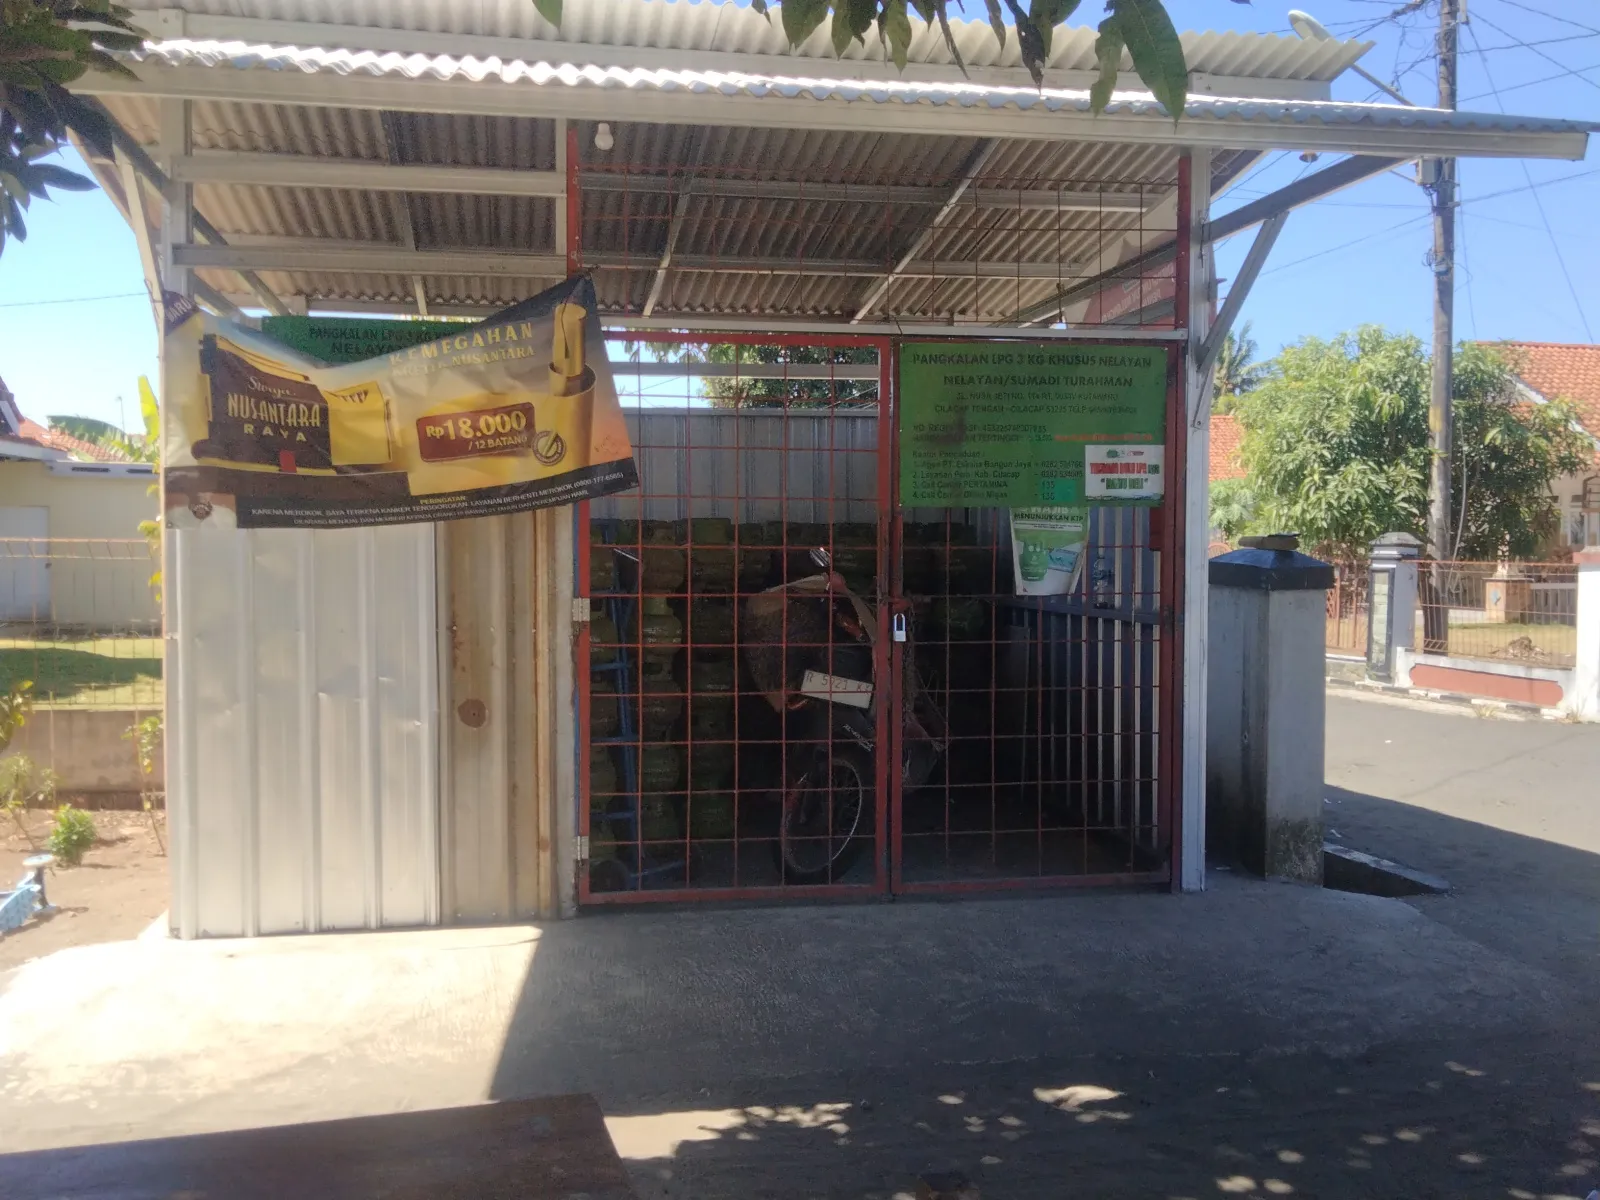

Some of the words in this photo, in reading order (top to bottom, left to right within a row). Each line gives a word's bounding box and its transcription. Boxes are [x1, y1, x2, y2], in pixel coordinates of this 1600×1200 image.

[390, 322, 533, 366] KEMEGAHAN
[451, 345, 536, 366] NUSANTARA
[913, 353, 989, 365] PANGKALAN
[992, 353, 1014, 365] LPG
[1017, 354, 1025, 364] 3
[1028, 353, 1045, 365] KG
[1048, 354, 1096, 366] KHUSUS
[1098, 355, 1152, 368] NELAYAN
[1064, 375, 1133, 388] TURAHMAN
[228, 391, 320, 428] NUSANTARA
[243, 422, 308, 442] RAYA
[425, 410, 526, 441] Rp18.000
[1014, 460, 1032, 471] Jaya
[992, 470, 1020, 482] Cilacap
[964, 480, 1008, 490] PERTAMINA
[252, 508, 284, 516] KARENA
[381, 505, 412, 515] KANKER
[1014, 512, 1069, 521] MENUNJUKKAN
